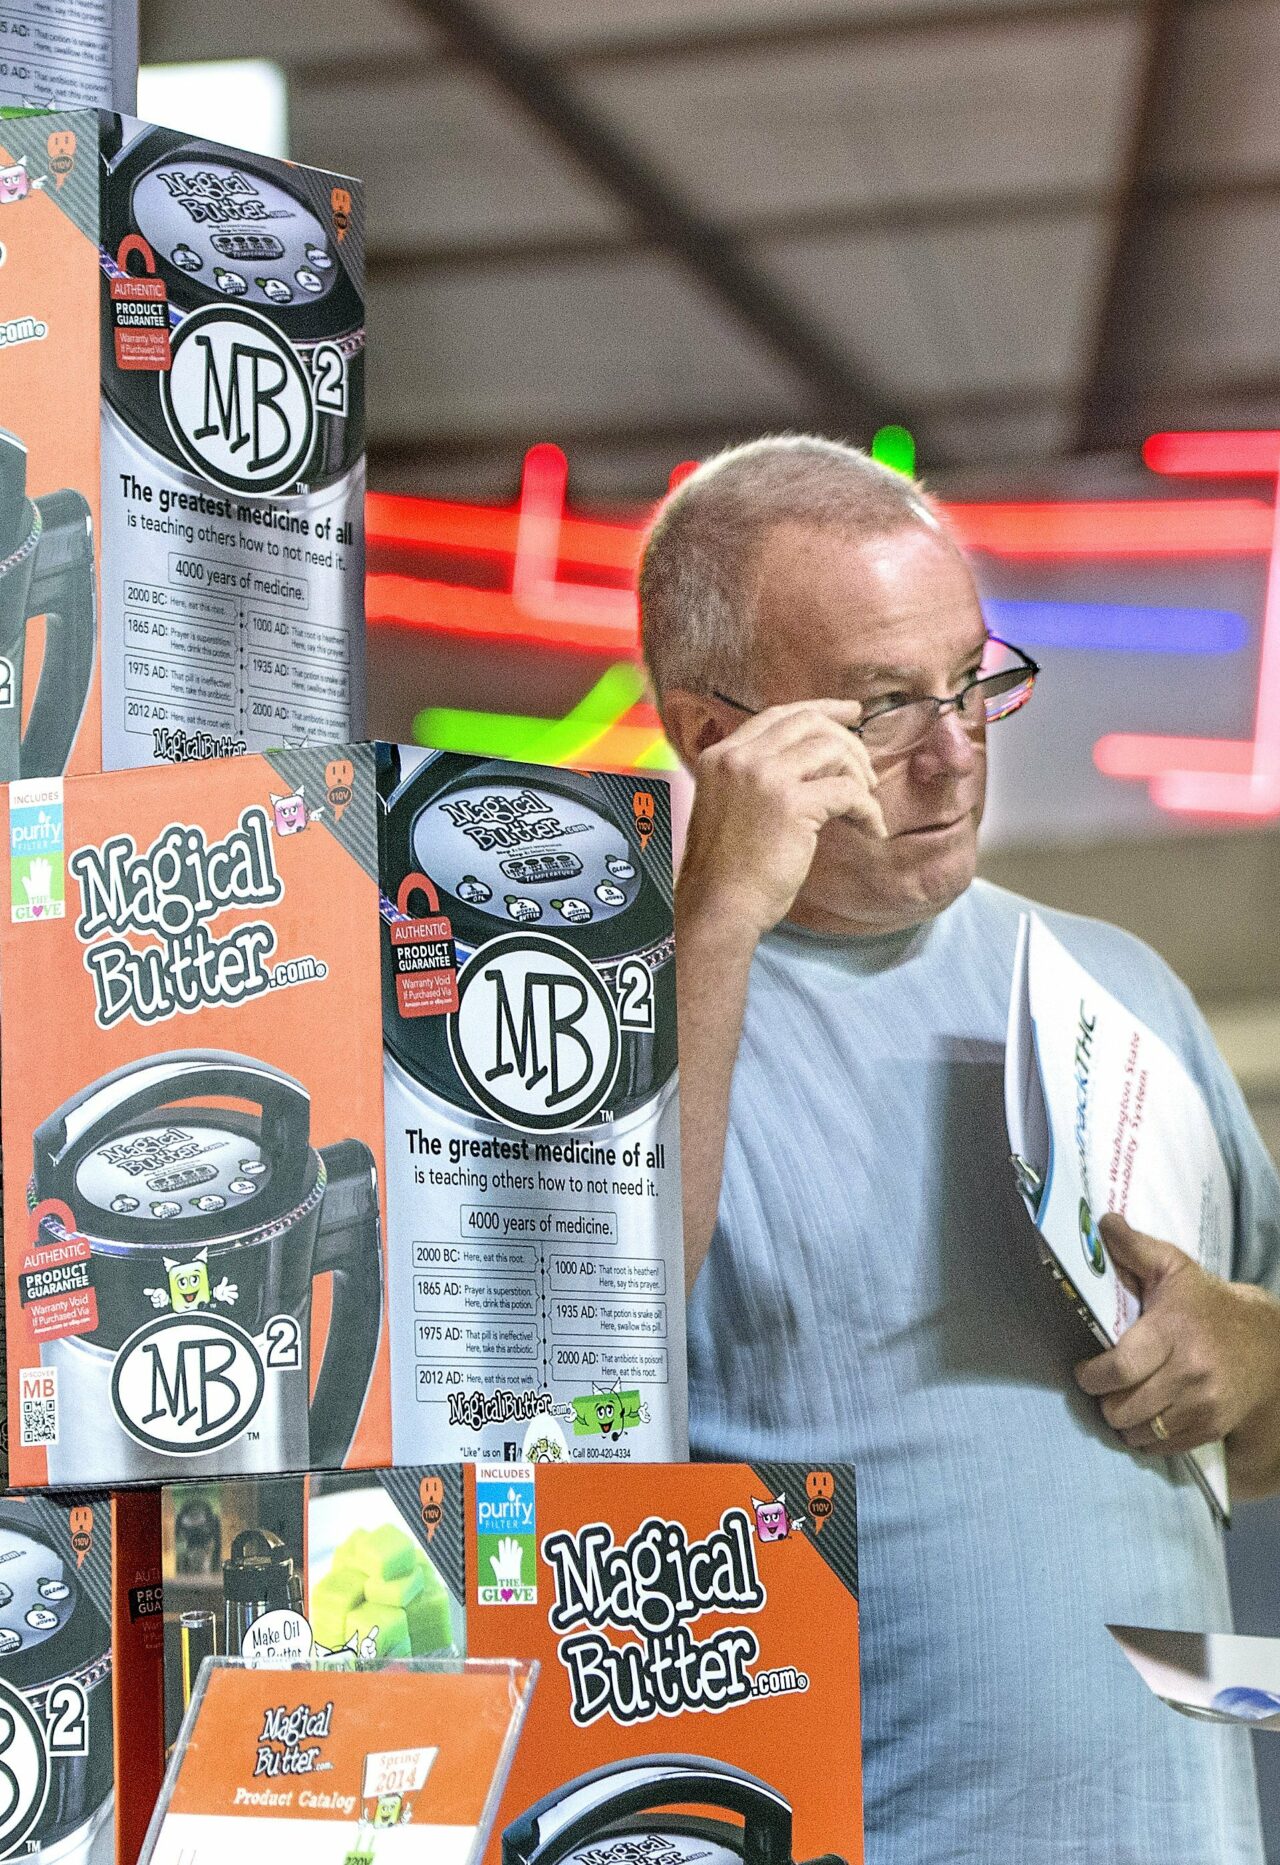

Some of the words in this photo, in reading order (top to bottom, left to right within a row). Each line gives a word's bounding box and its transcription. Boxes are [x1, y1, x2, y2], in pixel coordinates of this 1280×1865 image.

[160, 171, 260, 199] Magical
[114, 283, 162, 298] AUTHENTIC
[116, 302, 164, 316] PRODUCT
[117, 314, 165, 327] GUARANTEE
[193, 334, 291, 472] MB
[120, 474, 152, 502] The
[159, 489, 231, 520] greatest
[237, 505, 309, 536] medicine
[315, 517, 331, 540] of
[335, 521, 353, 546] all
[127, 510, 137, 527] is
[140, 513, 194, 543] teaching
[197, 525, 236, 547] others
[240, 535, 264, 554] how
[267, 540, 279, 556] to
[283, 543, 302, 562] not
[305, 551, 332, 568] need
[176, 559, 204, 581] 4000
[207, 569, 236, 587] years
[240, 572, 252, 588] of
[254, 576, 305, 601] medicine.
[127, 586, 150, 603] 2000
[152, 590, 168, 606] BC:
[128, 619, 149, 635] 1865
[151, 622, 168, 637] AD:
[253, 617, 273, 633] 1000
[274, 621, 290, 637] AD:
[128, 661, 149, 677] 1975
[151, 665, 168, 680] AD:
[253, 658, 273, 674] 1935
[274, 662, 290, 677] AD:
[128, 702, 150, 718] 2012
[151, 706, 168, 720] AD:
[252, 702, 273, 718] 2000
[274, 706, 290, 721] AD:
[14, 791, 60, 806] INCLUDES
[330, 789, 350, 801] 110V
[439, 790, 555, 827] Magical
[12, 812, 62, 848] purify
[72, 808, 282, 938] Magical
[525, 870, 576, 883] TEMPERATURE
[518, 911, 541, 922] BUTTER
[395, 922, 448, 940] AUTHENTIC
[397, 942, 449, 960] PRODUCT
[399, 957, 451, 972] GUARANTEE
[402, 976, 432, 990] Warranty
[433, 975, 451, 987] Void
[408, 987, 441, 1000] Purchased
[620, 961, 652, 1028] 2
[485, 968, 594, 1109] MB
[600, 1109, 614, 1123] TM
[1108, 1079, 1131, 1184] Washington
[1124, 1030, 1141, 1074] State
[98, 1128, 193, 1165] Magical
[405, 1128, 442, 1155] The
[449, 1136, 529, 1164] greatest
[536, 1140, 616, 1165] medicine
[622, 1142, 641, 1167] of
[646, 1143, 665, 1169] all
[414, 1165, 425, 1184] is
[429, 1167, 488, 1192] teaching
[492, 1169, 535, 1190] others
[539, 1171, 565, 1191] how
[569, 1175, 583, 1193] to
[587, 1177, 608, 1195] not
[612, 1177, 644, 1196] need
[647, 1178, 659, 1197] it.
[468, 1211, 500, 1230] 4000
[503, 1217, 536, 1234] years
[539, 1214, 553, 1233] of
[555, 1215, 613, 1236] medicine.
[24, 1243, 87, 1269] AUTHENTIC
[417, 1249, 442, 1262] 2000
[443, 1249, 461, 1263] BC:
[463, 1252, 483, 1265] Here,
[26, 1263, 88, 1288] PRODUCT
[555, 1261, 578, 1275] 1000
[579, 1262, 597, 1276] AD:
[27, 1277, 90, 1300] GUARANTEE
[417, 1282, 441, 1296] 1865
[443, 1282, 462, 1296] AD:
[464, 1285, 485, 1298] Prayer
[599, 1278, 617, 1289] Here,
[31, 1300, 67, 1318] Warranty
[69, 1295, 89, 1307] Void
[464, 1298, 482, 1309] Here,
[482, 1298, 498, 1309] drink
[556, 1305, 579, 1319] 1935
[580, 1306, 598, 1320] AD:
[39, 1310, 77, 1327] Purchased
[78, 1307, 90, 1317] Via
[418, 1327, 442, 1341] 1975
[444, 1327, 463, 1341] AD:
[465, 1330, 481, 1340] That
[600, 1321, 617, 1332] Here,
[266, 1318, 299, 1368] 2
[465, 1343, 482, 1354] Here,
[557, 1351, 581, 1365] 2000
[582, 1352, 599, 1366] AD:
[419, 1370, 443, 1385] 2012
[445, 1370, 464, 1385] AD:
[466, 1374, 483, 1386] Here,
[601, 1366, 620, 1378] Here,
[23, 1379, 55, 1399] MB
[142, 1338, 242, 1437] MB
[247, 1432, 260, 1442] TM
[573, 1447, 586, 1459] Call
[586, 1447, 631, 1459] 800-420-4334
[480, 1468, 531, 1480] INCLUDES
[478, 1490, 533, 1525] purify
[810, 1502, 831, 1514] 110V
[485, 1520, 519, 1529] FILTER
[499, 1578, 521, 1587] THE
[547, 1514, 762, 1636] Magical
[252, 1629, 281, 1650] Make
[283, 1620, 301, 1641] Oil
[50, 1683, 85, 1751] 2
[257, 1701, 335, 1747] Magical
[379, 1752, 421, 1765] Spring
[376, 1767, 417, 1791] 2014
[233, 1786, 293, 1808] Product
[298, 1789, 357, 1815] Catalog
[26, 1840, 42, 1854] TM
